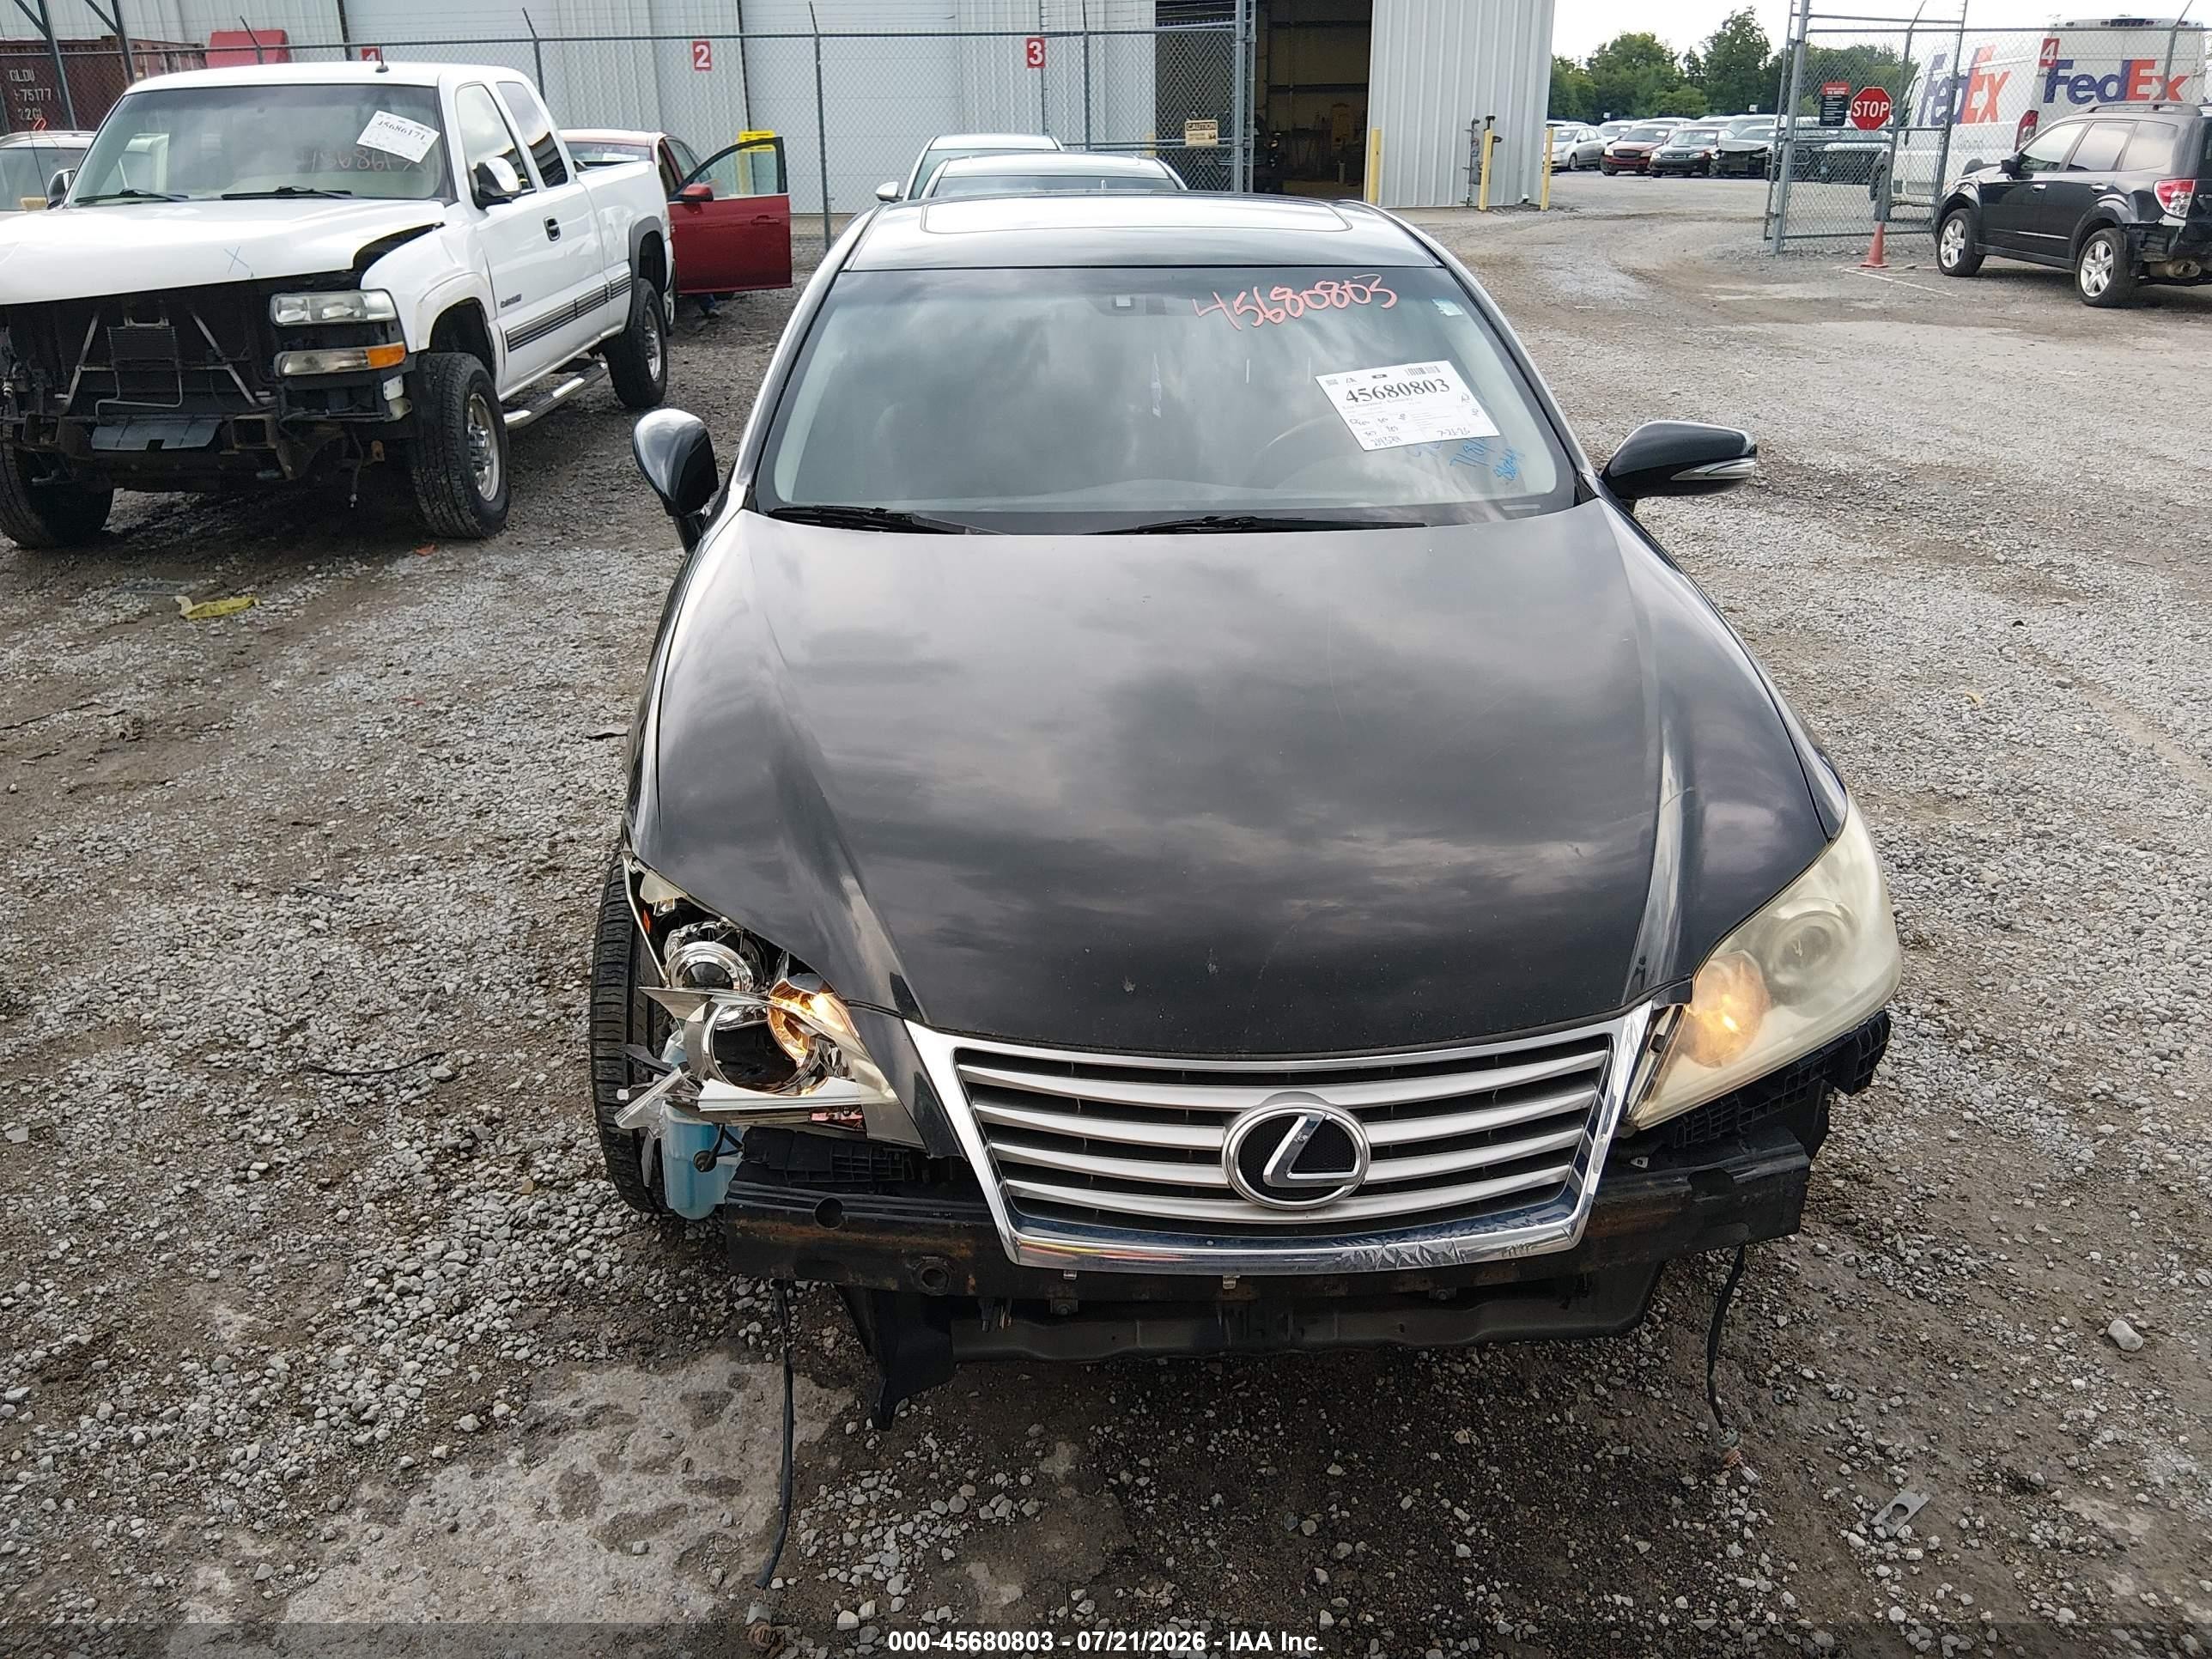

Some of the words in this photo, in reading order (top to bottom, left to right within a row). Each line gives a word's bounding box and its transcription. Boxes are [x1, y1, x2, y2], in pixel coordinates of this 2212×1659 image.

[696, 44, 709, 69] 2
[1029, 40, 1043, 65] 3
[2040, 41, 2056, 64] 4
[1917, 44, 2011, 126] FedEx
[2043, 59, 2190, 105] FedEx
[1852, 101, 1889, 118] STOP
[1192, 273, 1398, 331] 45680803
[1346, 378, 1450, 403] 45680803
